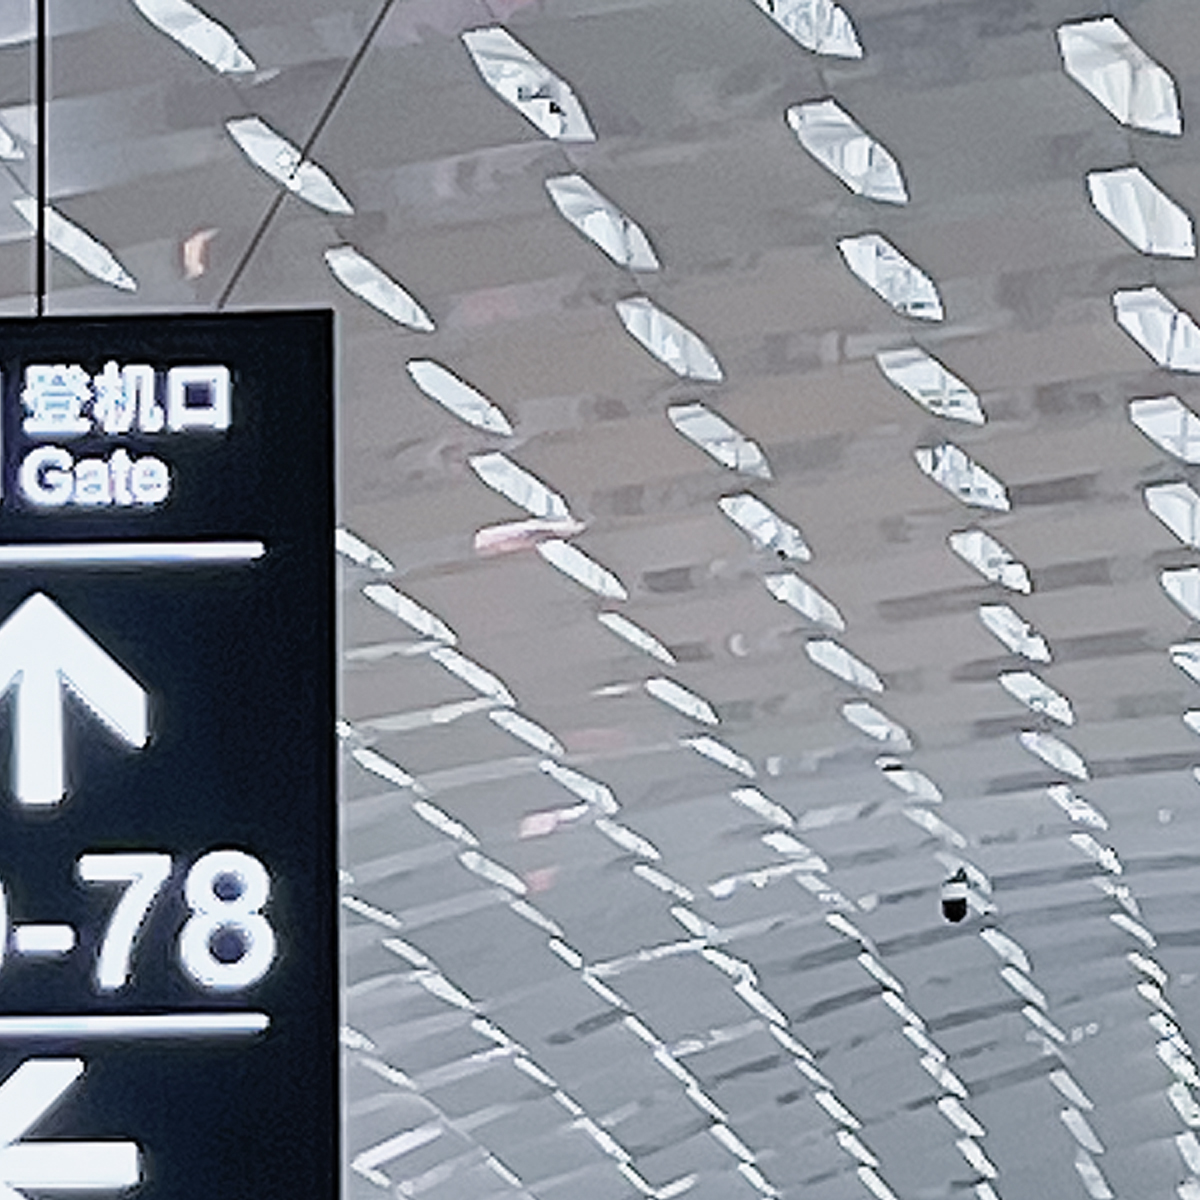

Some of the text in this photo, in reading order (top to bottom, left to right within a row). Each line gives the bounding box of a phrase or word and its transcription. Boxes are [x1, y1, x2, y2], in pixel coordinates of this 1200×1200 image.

[20, 361, 232, 435] 登机口
[19, 446, 171, 506] Gate
